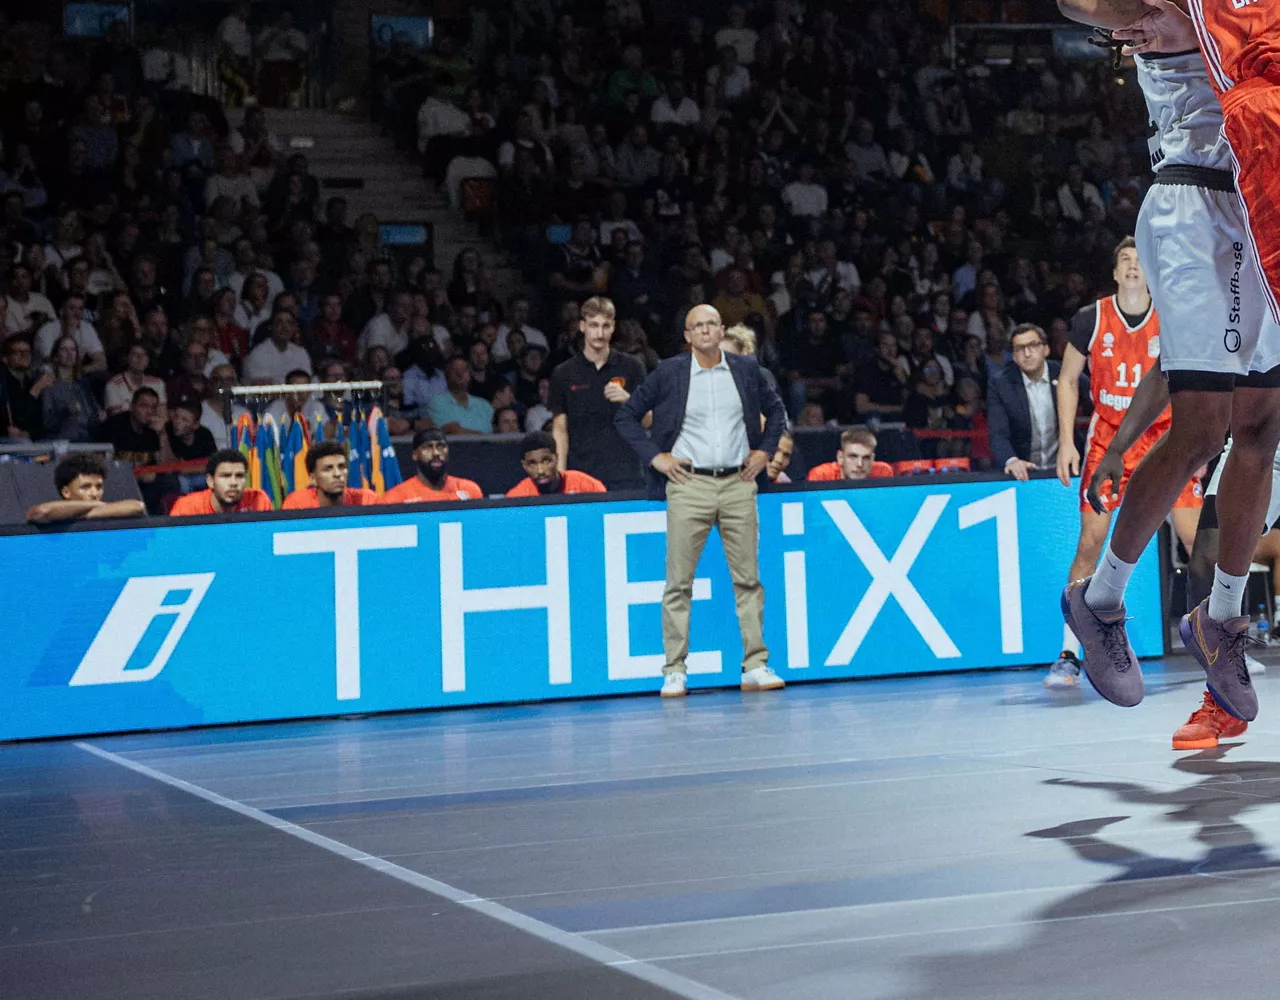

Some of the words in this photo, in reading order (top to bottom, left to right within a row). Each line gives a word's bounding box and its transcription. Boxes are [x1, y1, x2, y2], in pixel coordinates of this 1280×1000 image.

[1229, 241, 1243, 324] Staffbase
[1115, 362, 1142, 388] 11
[273, 511, 722, 700] THE
[782, 487, 1024, 669] iX1
